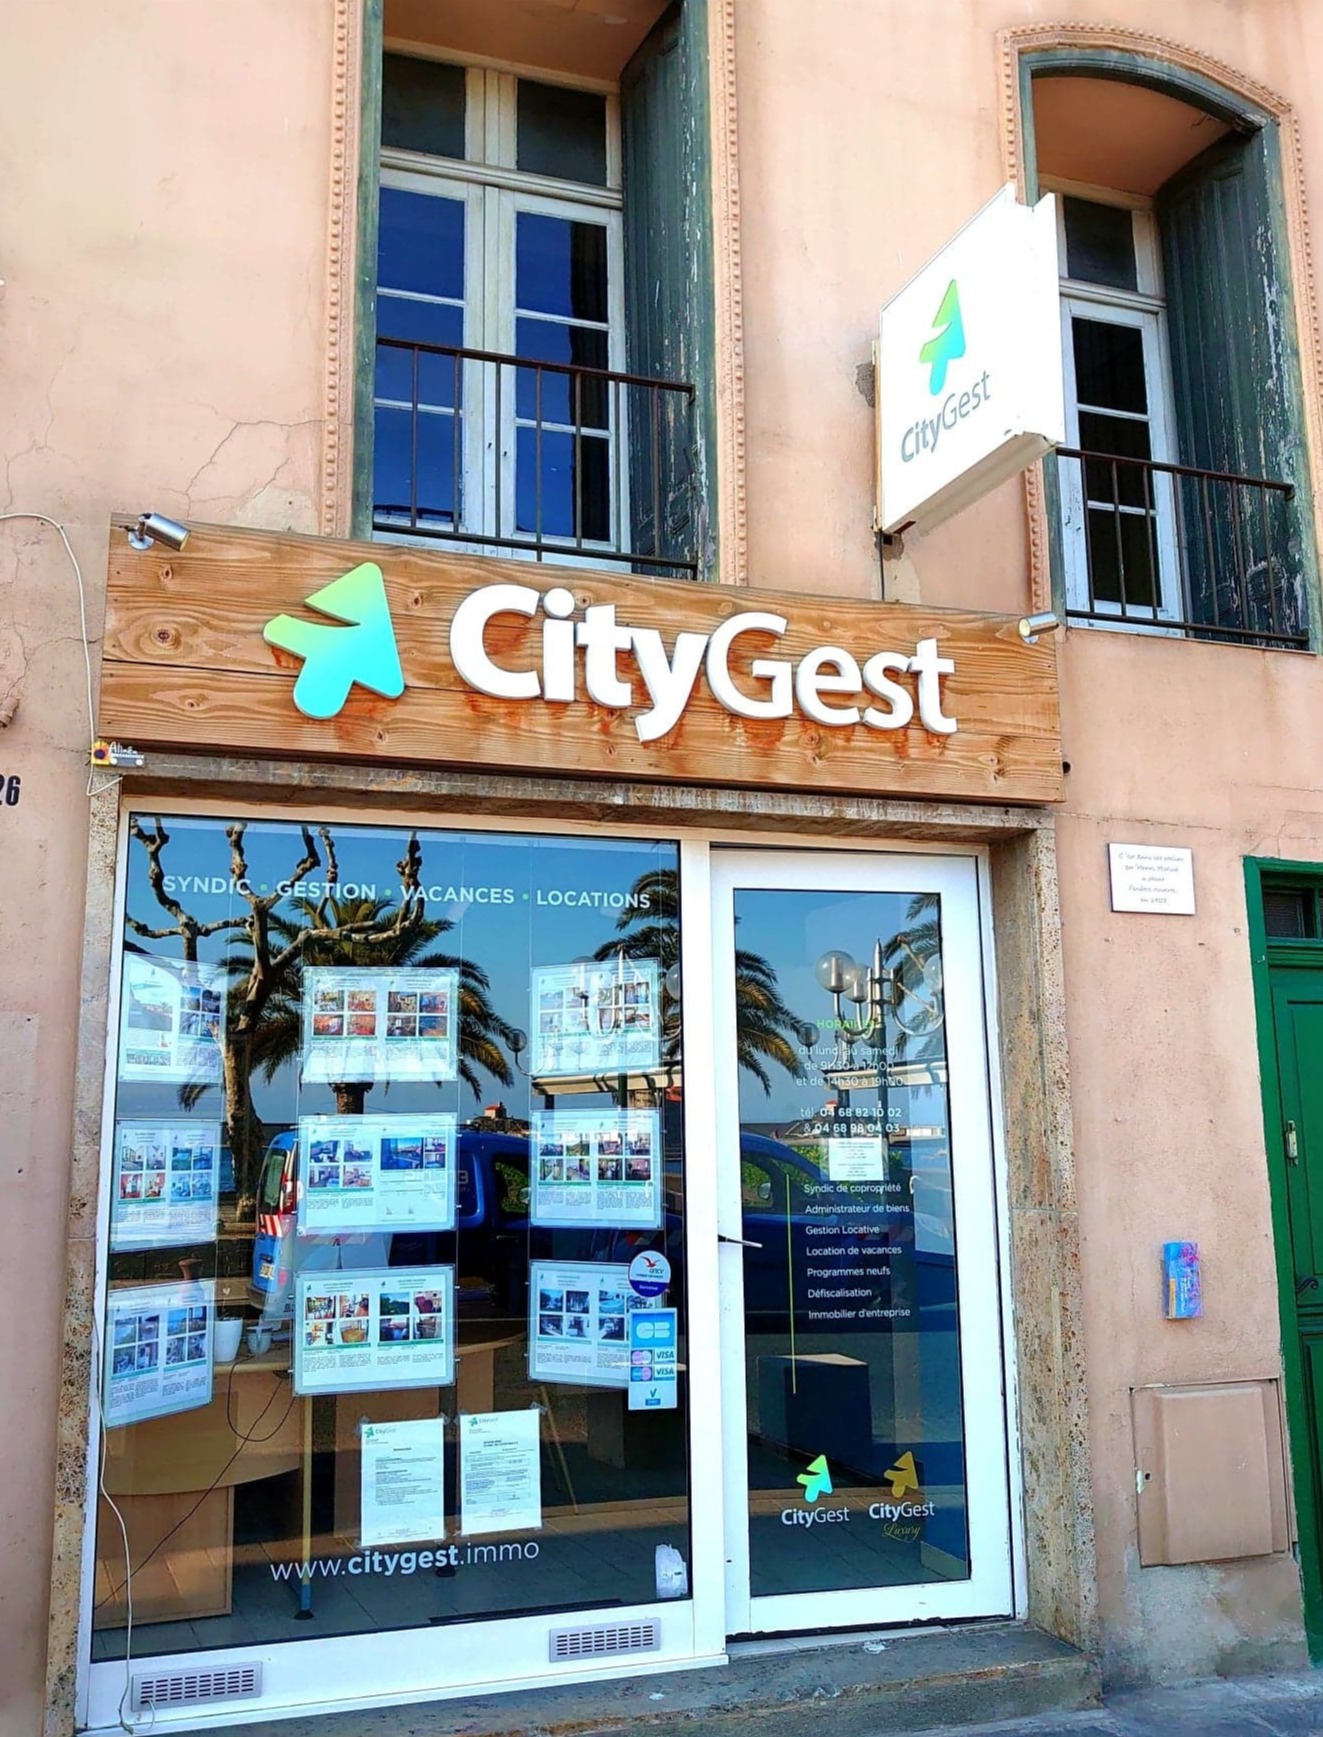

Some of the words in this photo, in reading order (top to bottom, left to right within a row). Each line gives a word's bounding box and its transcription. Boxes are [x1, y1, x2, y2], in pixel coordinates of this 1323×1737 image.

[901, 370, 990, 463] CityGest
[449, 583, 958, 744] CityGest
[162, 876, 252, 895] SYNDIC
[276, 880, 376, 900] GESTION
[399, 885, 514, 904] VACANCES
[536, 889, 651, 909] LOCATIONS
[804, 1062, 818, 1071] de
[796, 1077, 807, 1087] et
[810, 1076, 824, 1087] de
[820, 1107, 835, 1117] 04
[838, 1107, 852, 1117] 68
[855, 1107, 869, 1117] 82
[872, 1107, 884, 1117] 10
[887, 1107, 902, 1117] 02
[815, 1123, 830, 1133] 04
[832, 1123, 847, 1133] 68
[850, 1123, 864, 1133] 98
[868, 1122, 882, 1133] 04
[885, 1122, 900, 1132] 03
[804, 1183, 834, 1195] Syndic
[836, 1183, 848, 1193] de
[850, 1183, 901, 1195] copropriété
[805, 1204, 870, 1214] Administrateur
[872, 1204, 884, 1213] de
[886, 1204, 910, 1213] biens
[806, 1226, 840, 1235] Gestion
[842, 1225, 880, 1234] Locative
[806, 1247, 846, 1256] Location
[848, 1247, 859, 1255] de
[861, 1246, 902, 1255] vacances
[807, 1268, 864, 1278] Programmes
[866, 1266, 891, 1276] neufs
[808, 1288, 872, 1298] Défiscalisation
[808, 1309, 857, 1320] Immobilier
[858, 1308, 911, 1319] d'entreprise
[656, 1350, 675, 1359] VISA
[656, 1366, 675, 1376] VISA
[868, 1501, 936, 1522] CityGest
[781, 1507, 850, 1528] CityGest
[270, 1539, 540, 1582] www.citygest.immo
